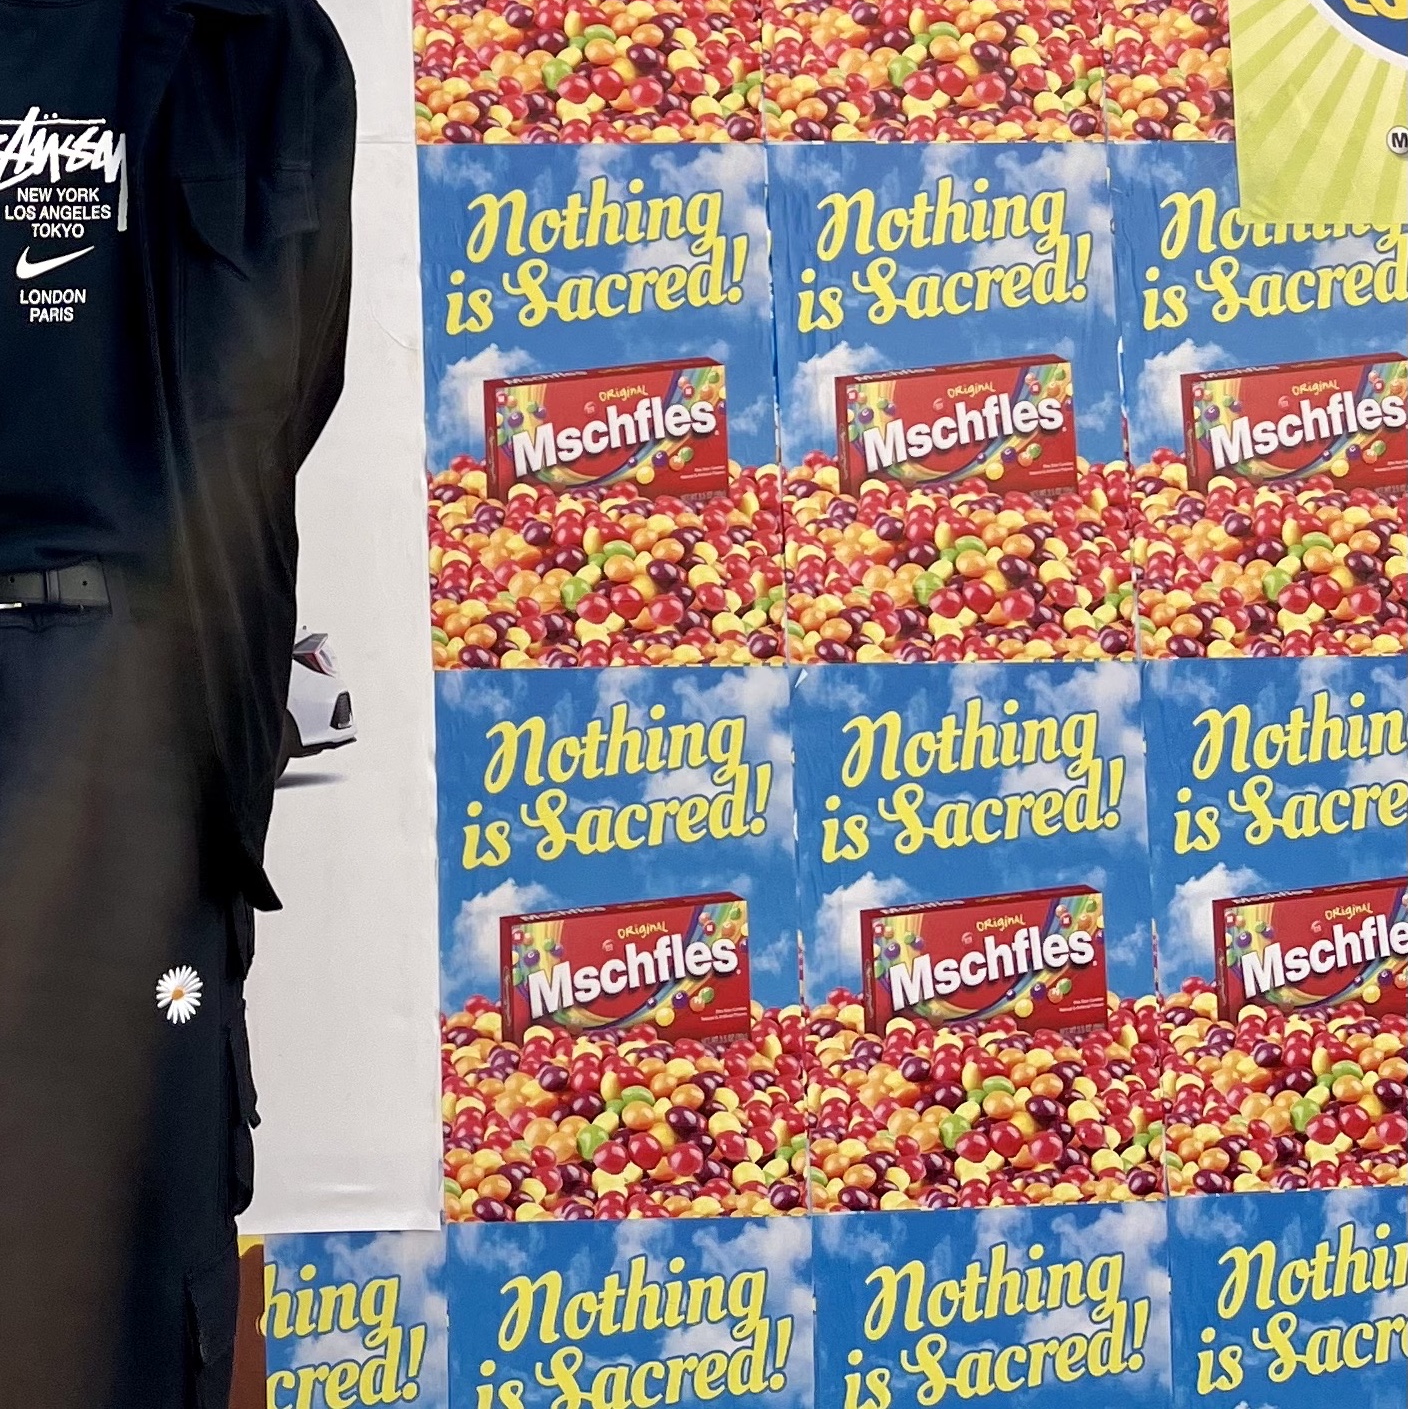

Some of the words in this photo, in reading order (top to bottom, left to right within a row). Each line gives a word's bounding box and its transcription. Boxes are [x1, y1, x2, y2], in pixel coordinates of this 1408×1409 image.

[4, 205, 36, 220] LOS
[39, 205, 111, 220] ANGELES
[17, 188, 52, 202] NEW
[56, 188, 99, 202] YORK
[31, 223, 85, 238] TOKYO
[466, 177, 723, 263] Nothing
[816, 177, 1066, 263] Nothing
[20, 289, 86, 304] LONDON
[30, 308, 74, 322] PARIS
[446, 269, 493, 335] is
[503, 235, 749, 328] Sacred!
[797, 267, 844, 334] is
[853, 233, 1092, 324] Sacred!
[1143, 270, 1188, 330] is
[512, 396, 717, 478] Mschfles
[863, 393, 1064, 472] Mschfles
[1210, 391, 1407, 470] Mschfles
[483, 702, 747, 794] Nothing
[841, 696, 1098, 789] Nothing
[462, 800, 511, 869] is
[521, 762, 774, 862] Sacred!
[821, 795, 869, 864] is
[878, 757, 1126, 855] Sacred!
[1174, 786, 1221, 854] is
[528, 933, 738, 1019] Mschfles
[890, 926, 1094, 1011] Mschfles
[498, 1255, 768, 1352] Nothing
[864, 1243, 1125, 1342] Nothing
[536, 1317, 794, 1409] Sacred!
[844, 1348, 891, 1409] is
[901, 1300, 1151, 1406] Sacred!
[1196, 1327, 1244, 1395] is
